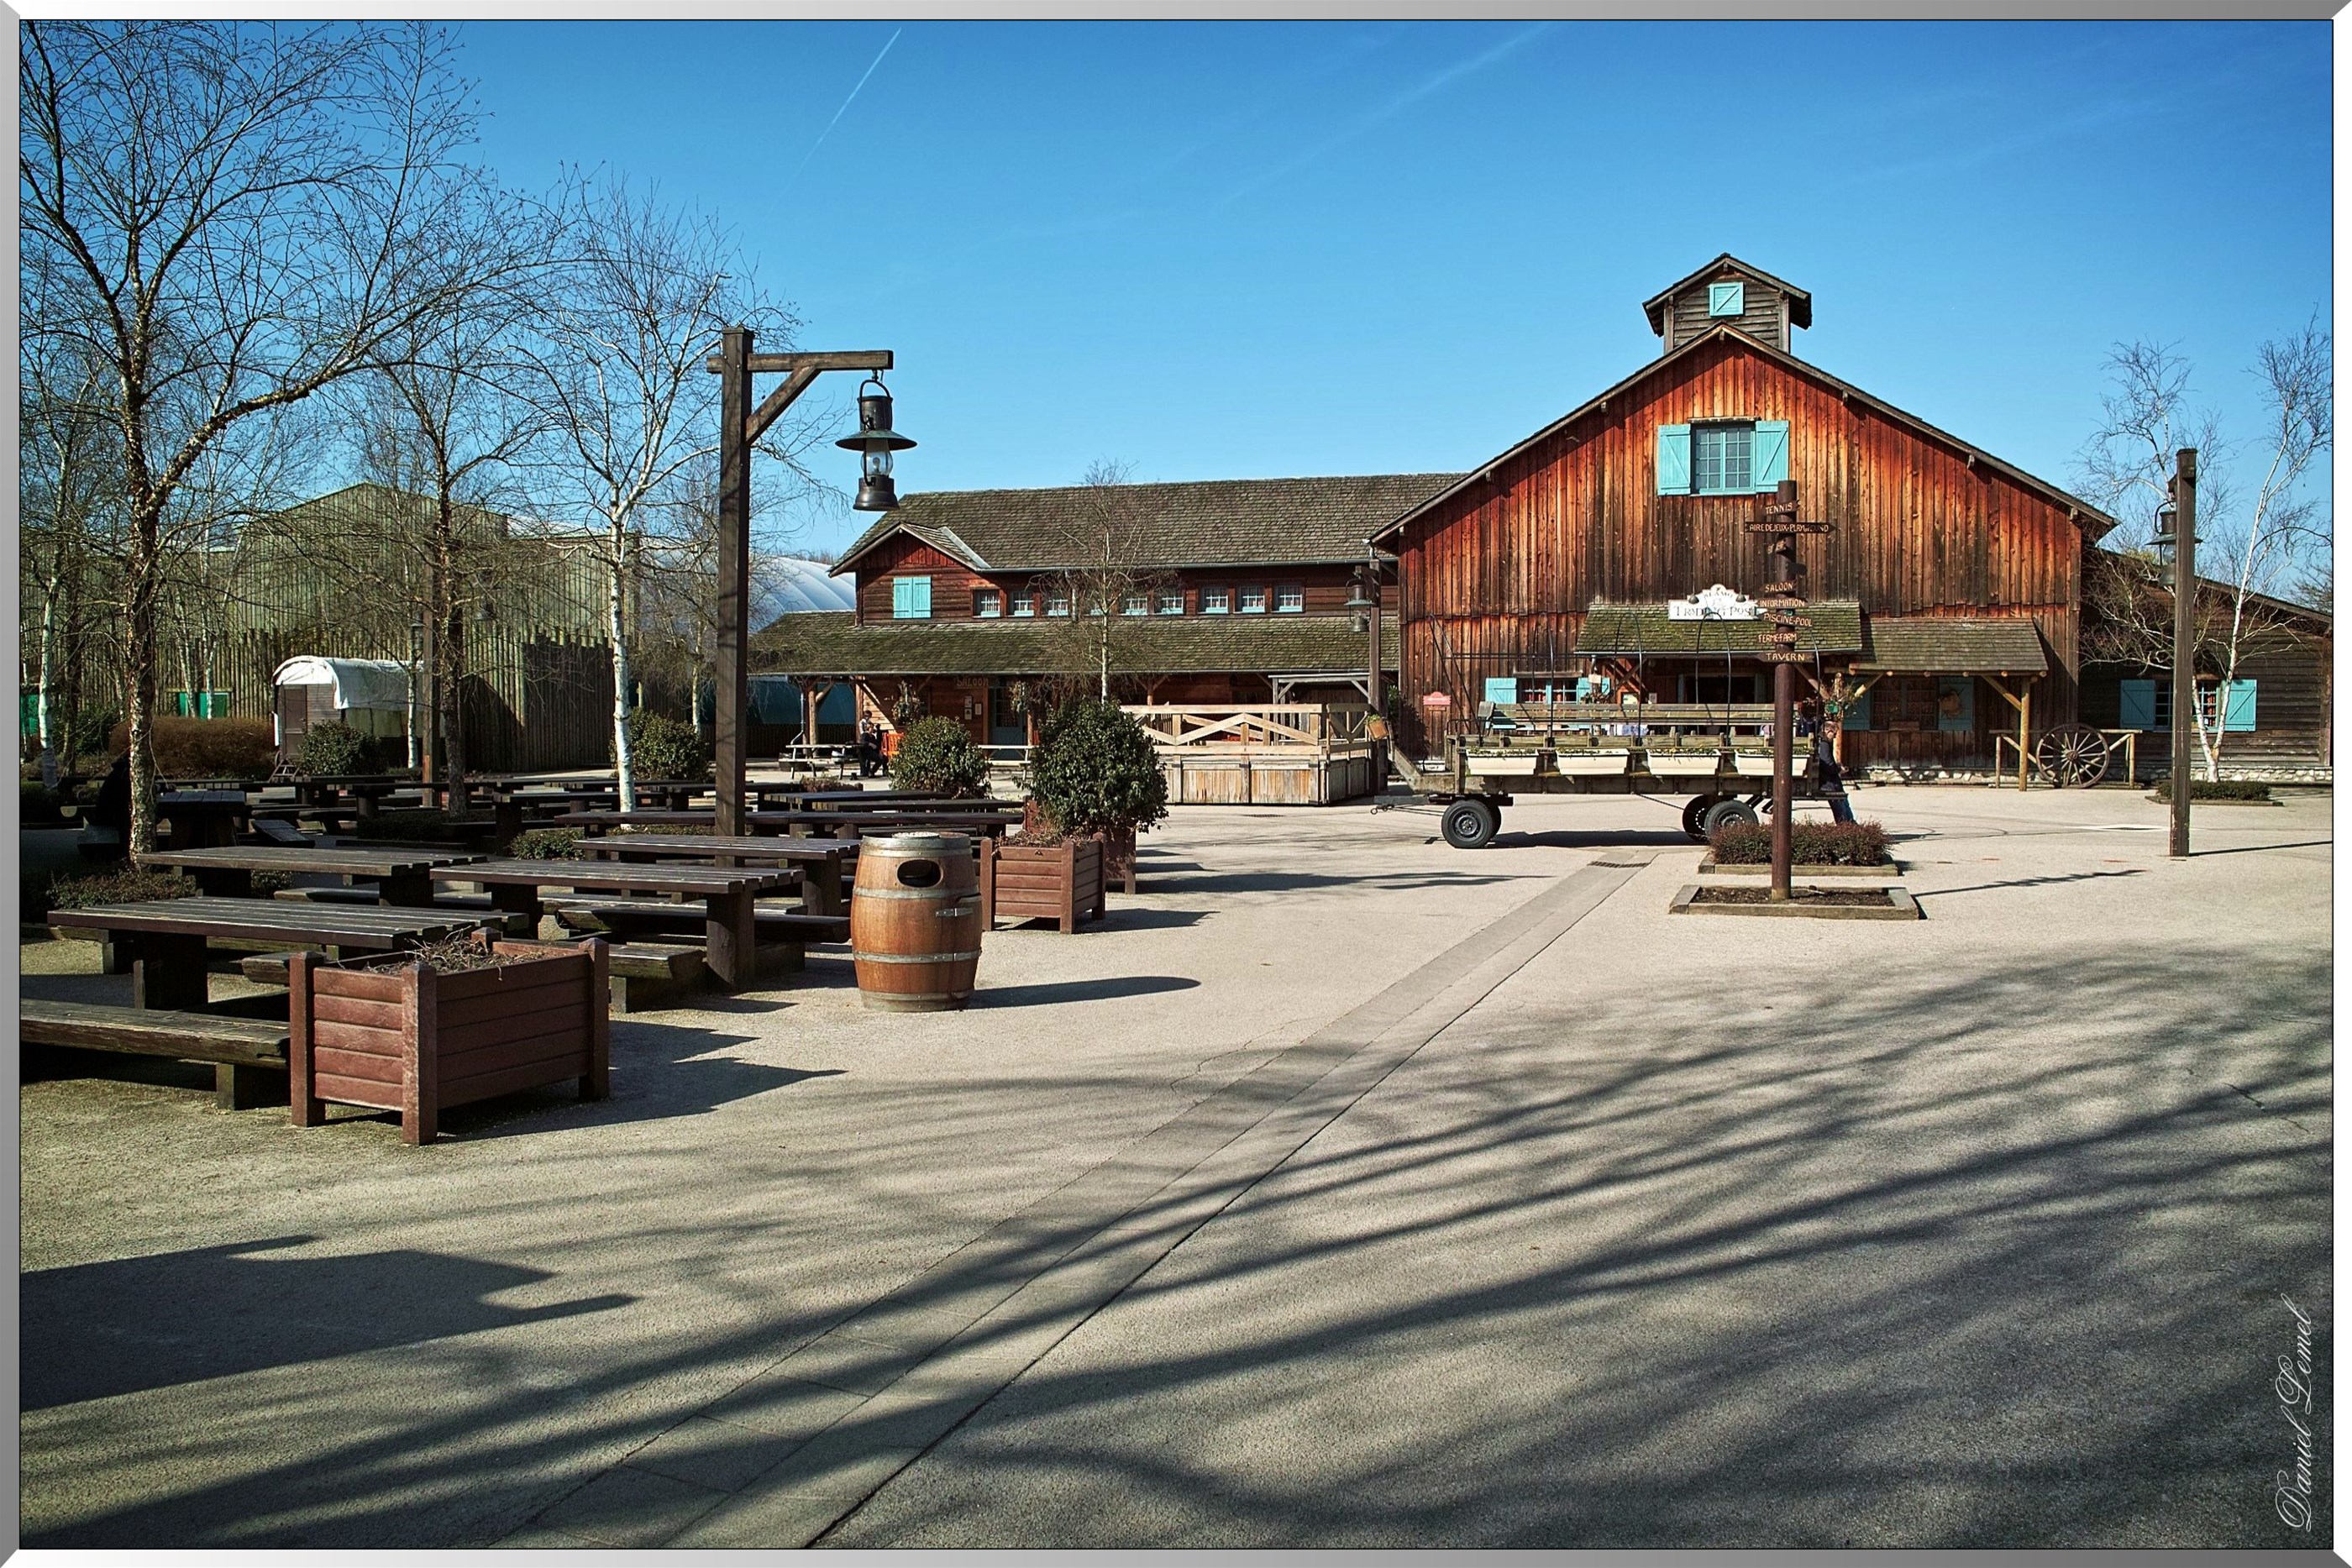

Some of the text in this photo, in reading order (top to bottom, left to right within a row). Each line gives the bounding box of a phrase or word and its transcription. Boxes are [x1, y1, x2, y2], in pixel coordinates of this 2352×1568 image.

[1765, 501, 1793, 515] TENNIS
[1749, 523, 1765, 532] AIRE
[1765, 582, 1794, 593] SALOON
[1760, 599, 1805, 607] INFORMATION
[1766, 653, 1805, 662] TAVERN
